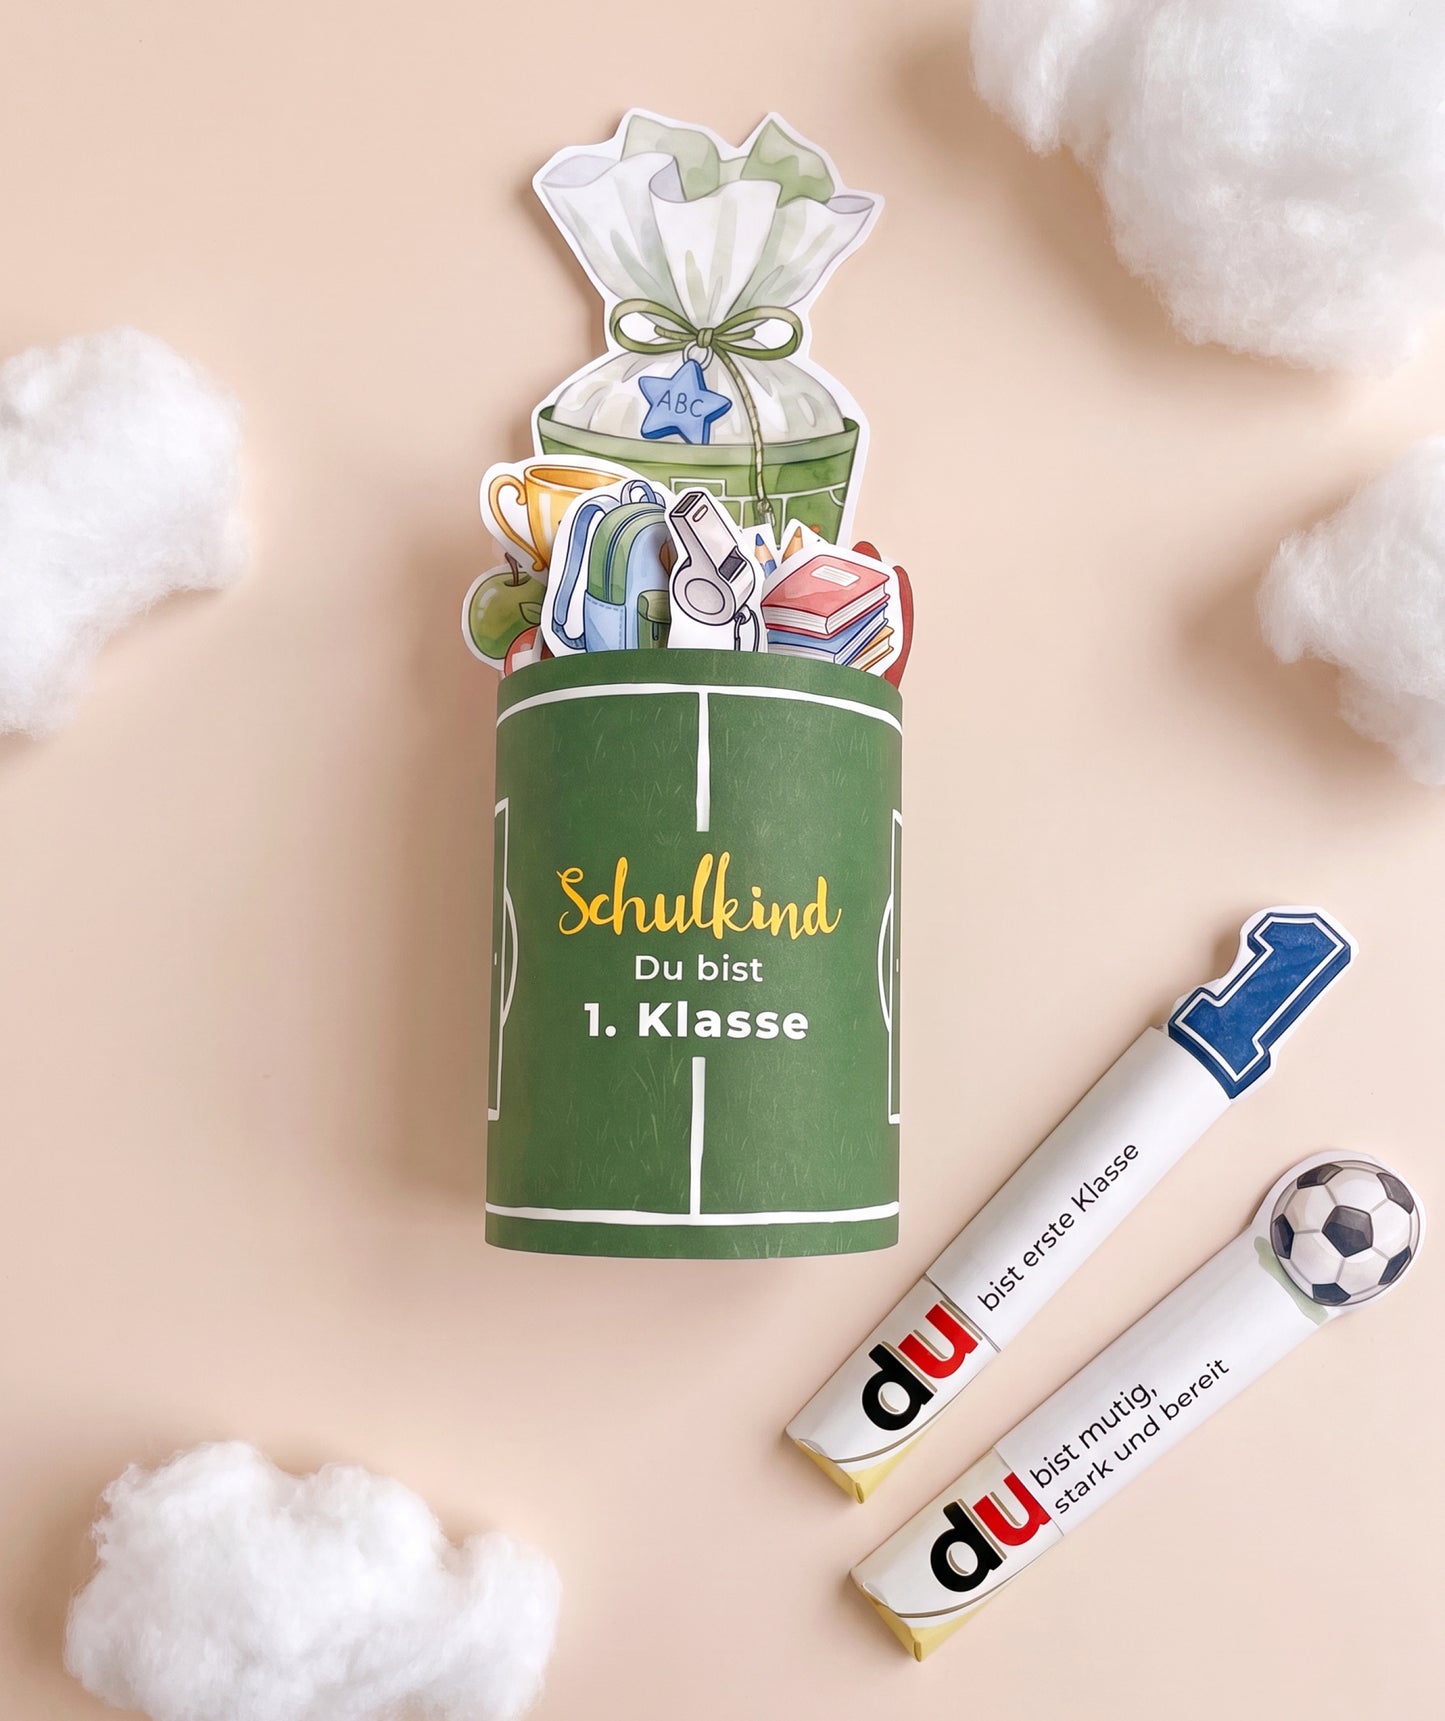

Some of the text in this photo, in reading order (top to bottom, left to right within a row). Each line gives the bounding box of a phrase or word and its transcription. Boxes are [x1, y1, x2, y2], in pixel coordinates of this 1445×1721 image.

[656, 389, 704, 418] ABC
[556, 851, 842, 940] Schulkind
[634, 953, 764, 983] Du bist
[583, 1000, 810, 1040] 1. Klasse
[861, 1142, 1140, 1432] du bist erste Klasse
[1054, 1357, 1230, 1515] stark und bereit
[929, 1381, 1159, 1593] du bist mutig,
